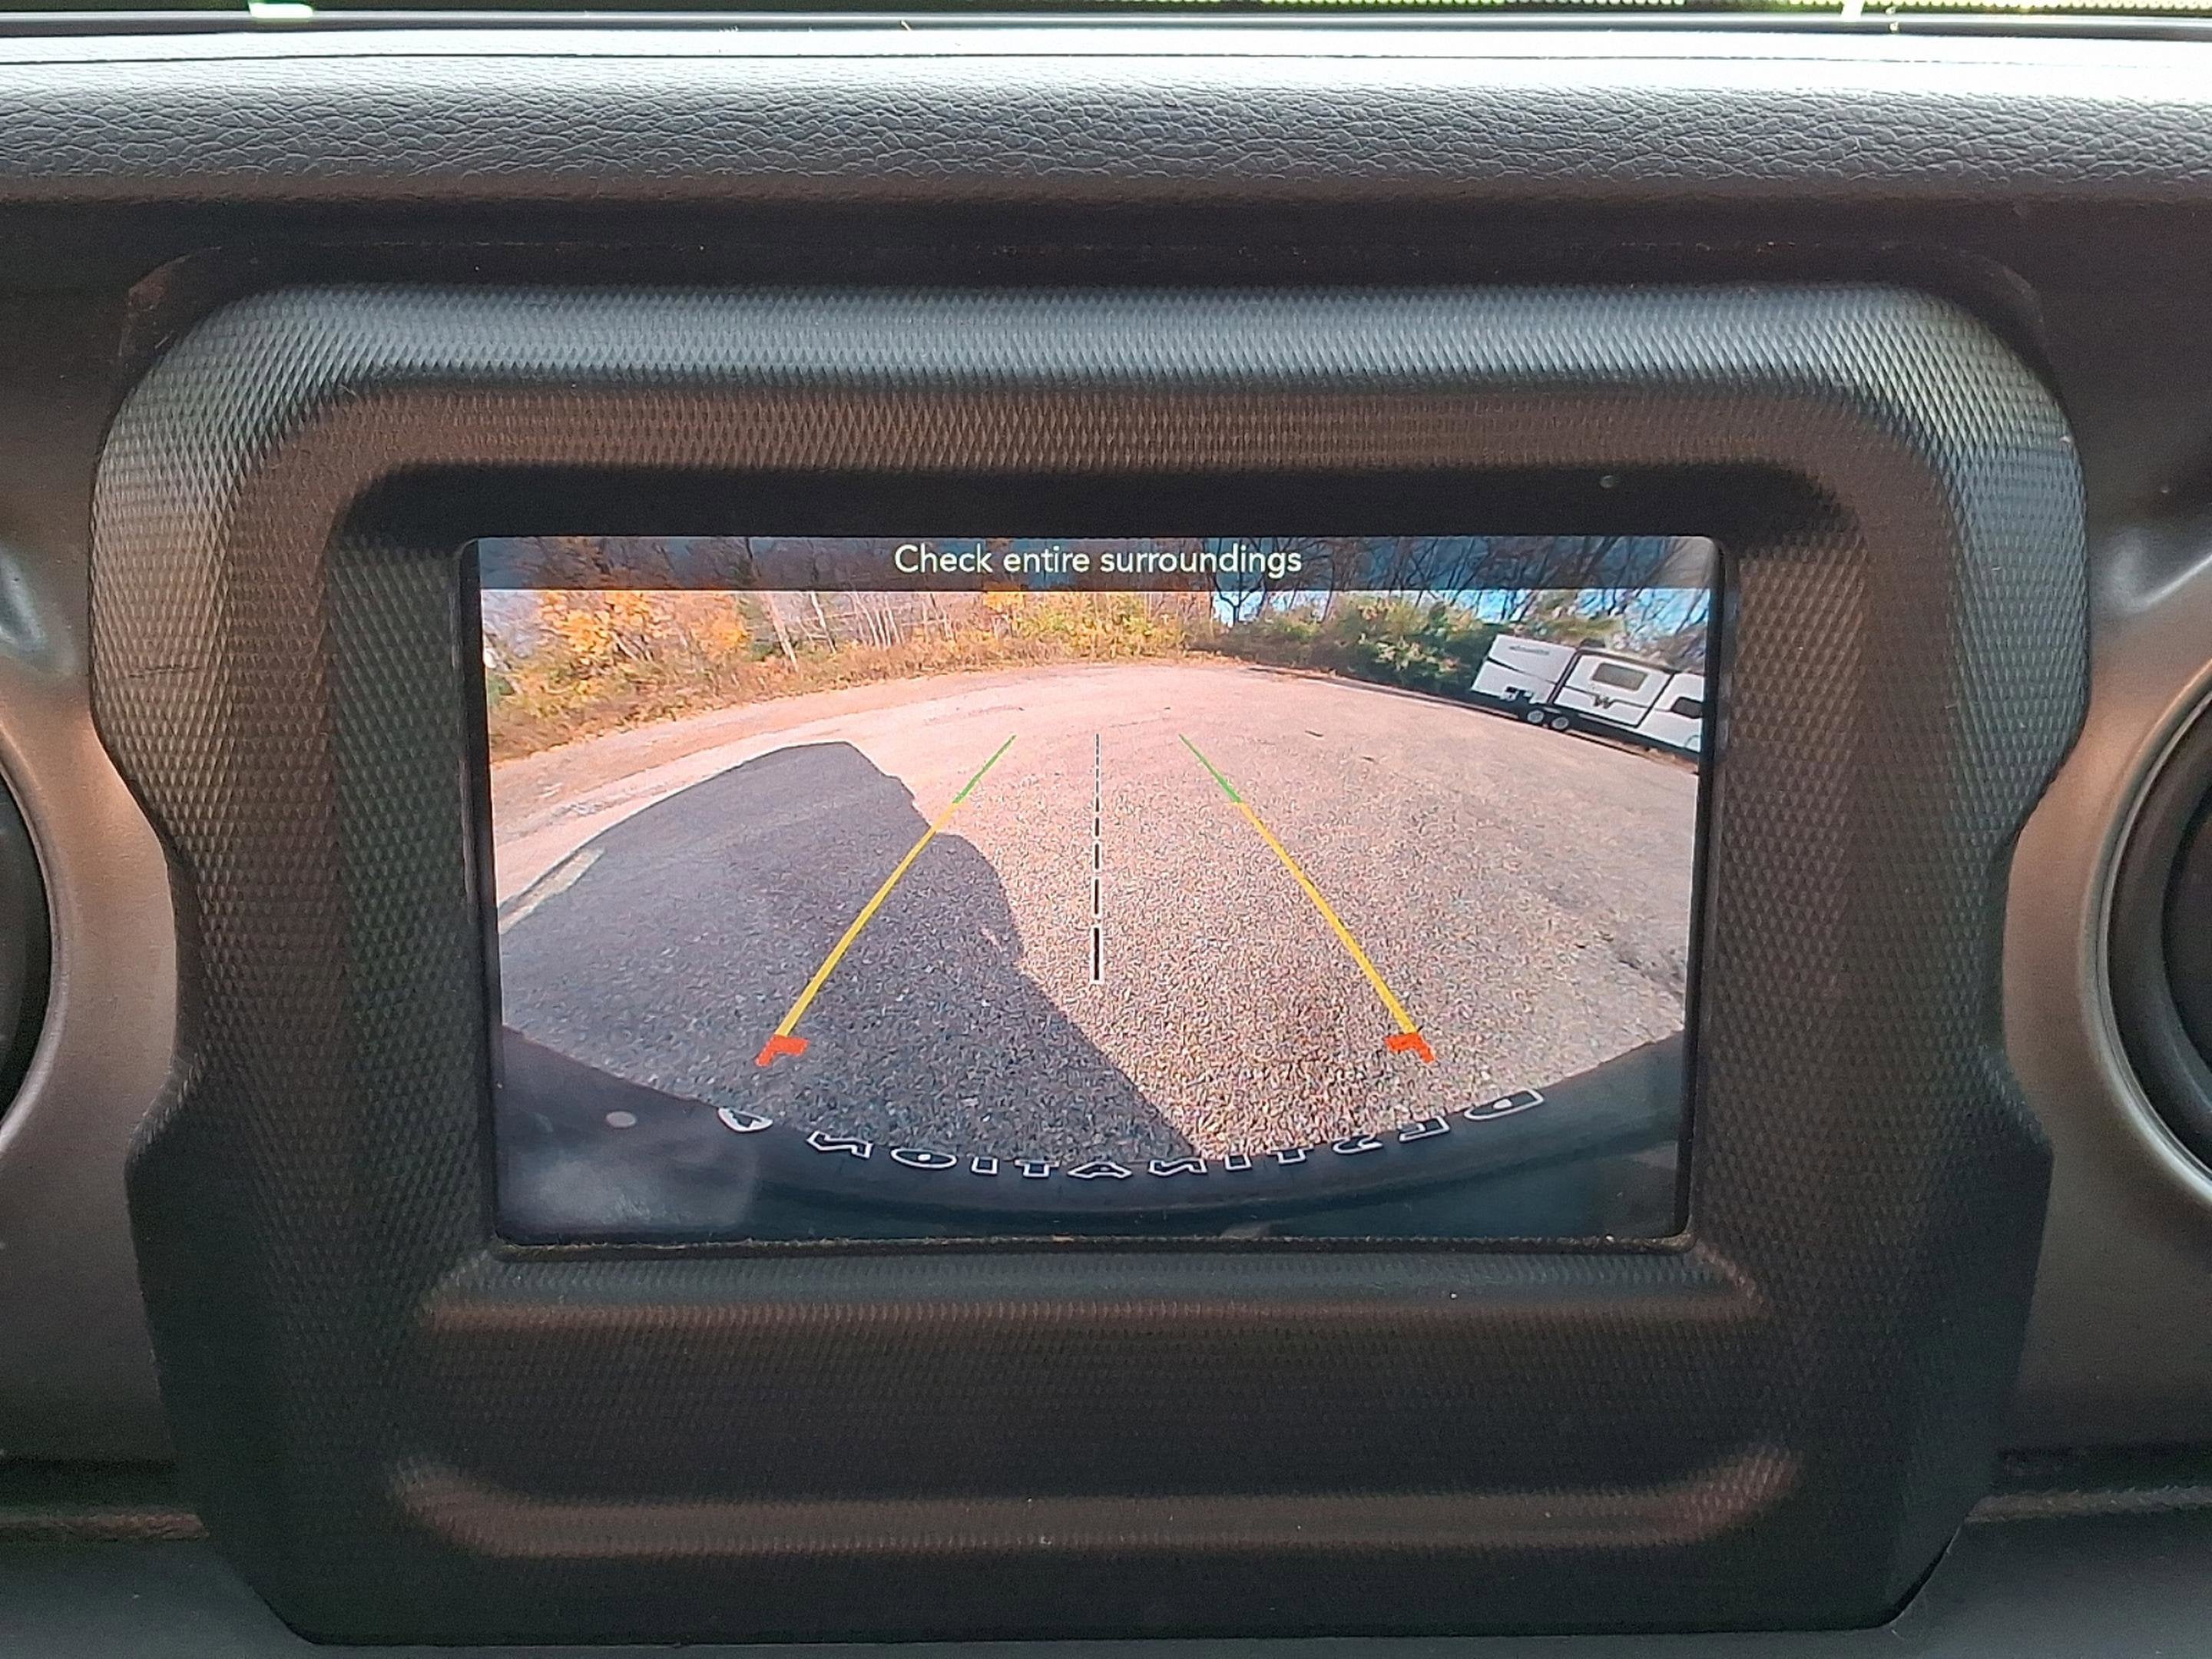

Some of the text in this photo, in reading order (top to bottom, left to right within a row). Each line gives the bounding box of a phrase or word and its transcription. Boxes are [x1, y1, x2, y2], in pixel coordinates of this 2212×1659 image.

[894, 543, 1303, 578] Check entire surroundings
